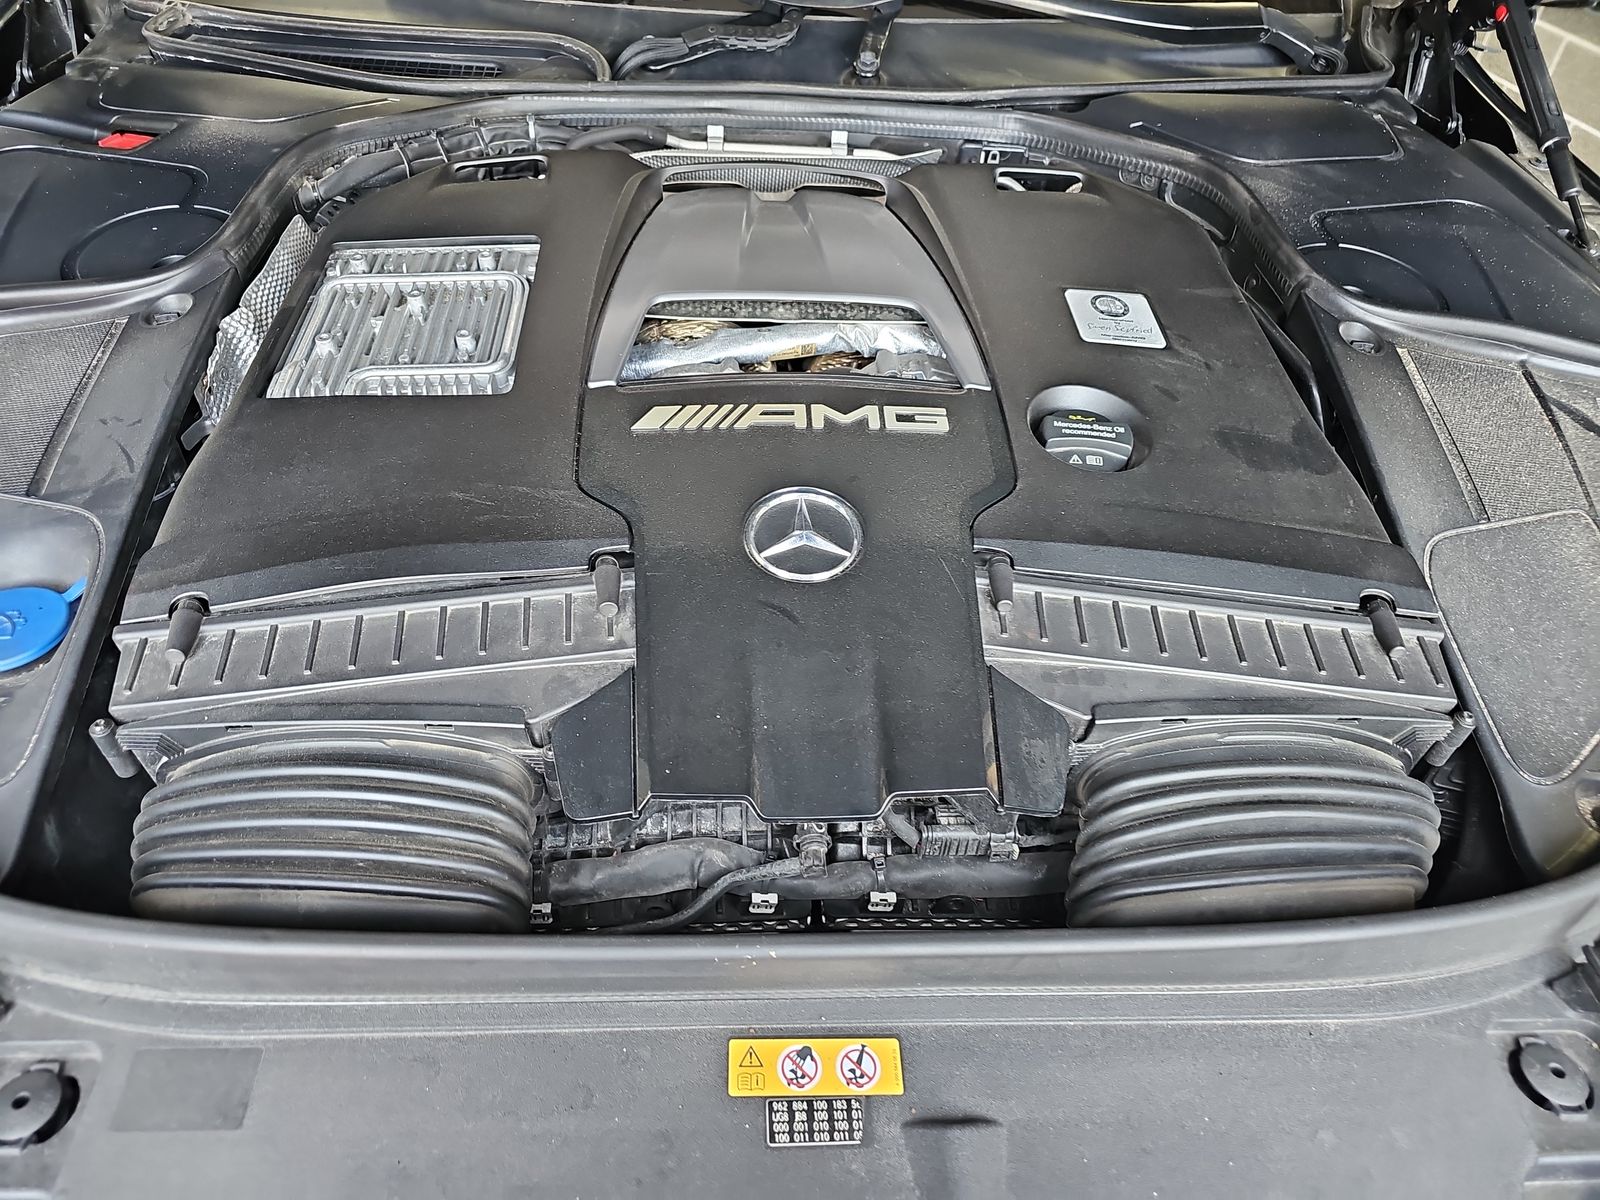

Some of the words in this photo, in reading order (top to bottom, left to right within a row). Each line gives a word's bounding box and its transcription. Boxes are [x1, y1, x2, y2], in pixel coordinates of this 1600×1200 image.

[733, 403, 950, 432] AMG
[1053, 420, 1113, 432] Mercedes-Benz
[1061, 428, 1117, 438] recommended
[812, 1100, 828, 1110] 100
[813, 1110, 829, 1121] 100
[833, 1110, 848, 1120] 101
[772, 1121, 789, 1133] 000
[793, 1121, 809, 1132] 001
[812, 1121, 829, 1131] 010
[834, 1120, 849, 1131] 100
[774, 1132, 790, 1143] 100
[793, 1132, 809, 1142] 011
[813, 1131, 830, 1142] 010
[833, 1131, 849, 1141] 011
